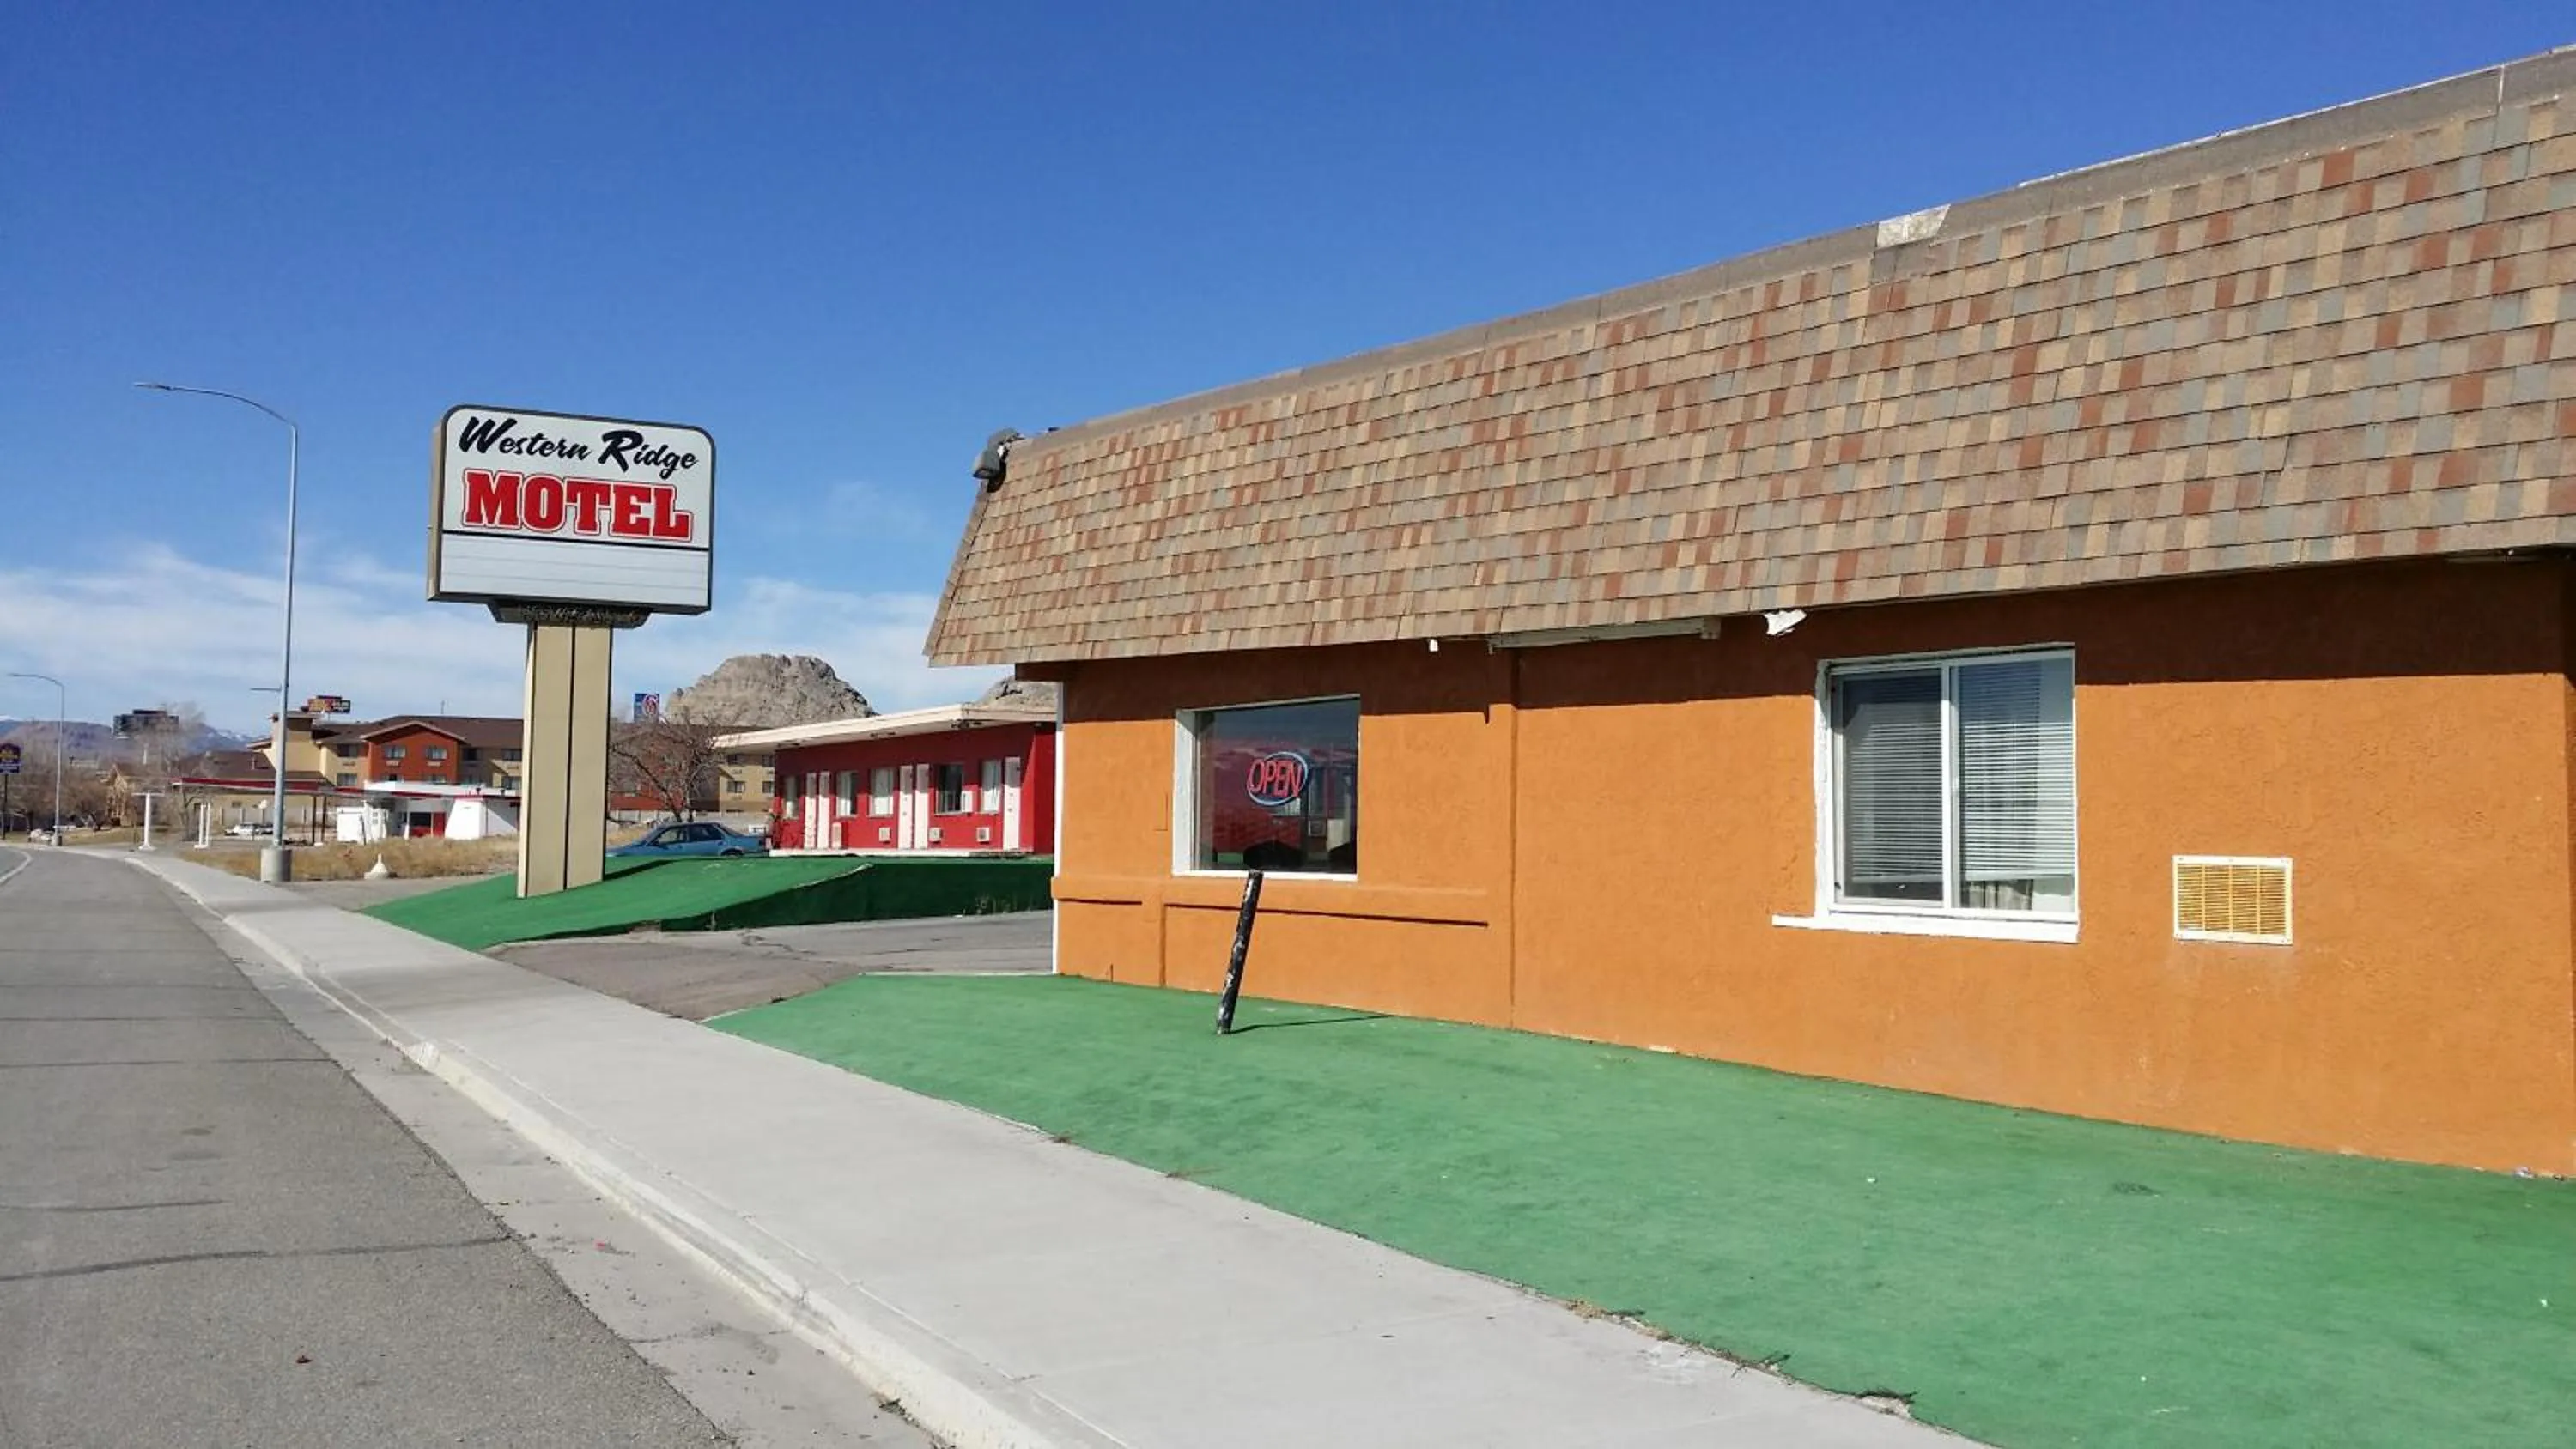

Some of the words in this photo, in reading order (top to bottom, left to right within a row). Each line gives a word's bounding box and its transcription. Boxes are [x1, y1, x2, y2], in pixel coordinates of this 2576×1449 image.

[459, 416, 591, 461] Western
[598, 429, 699, 480] Ridge
[463, 469, 693, 542] MOTEL
[1249, 759, 1302, 797] OPEN
